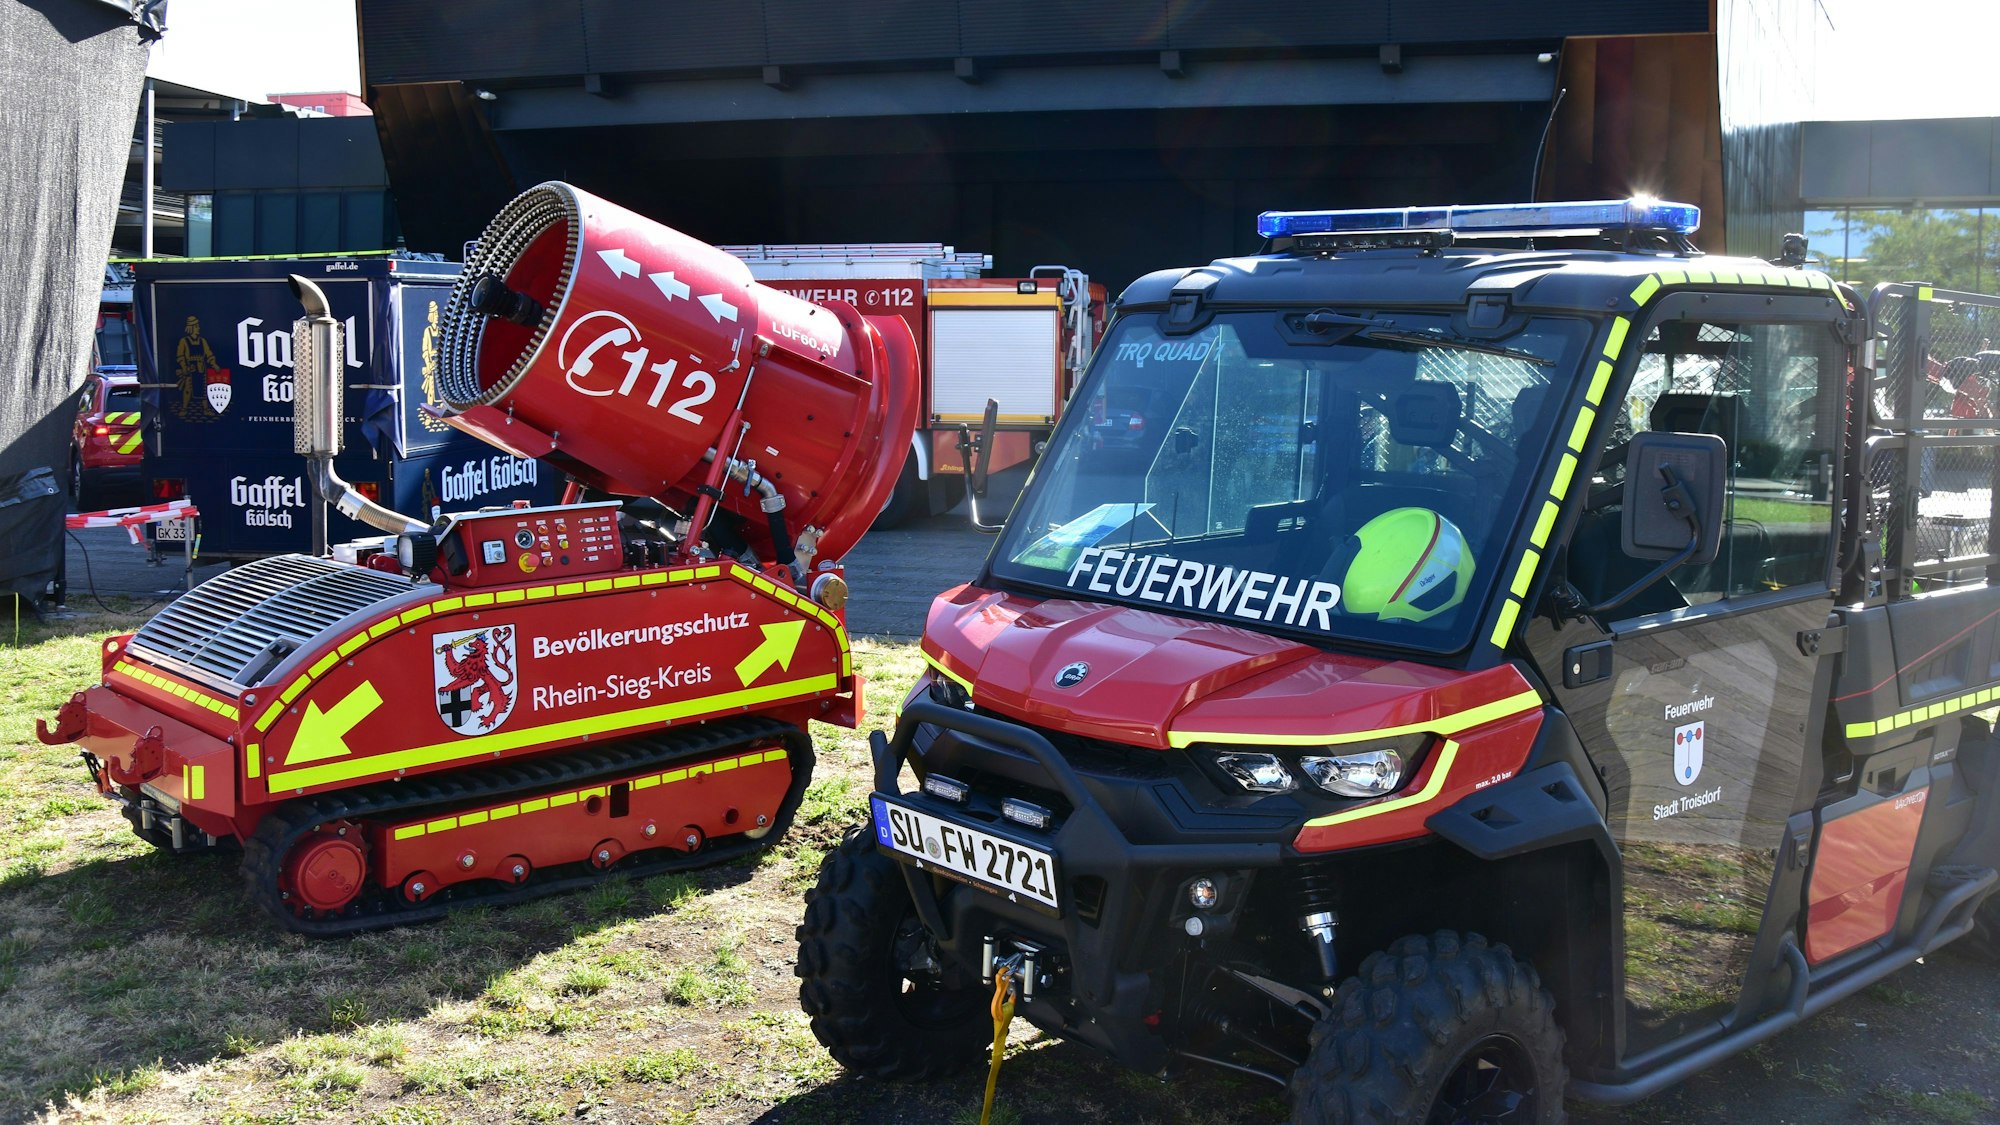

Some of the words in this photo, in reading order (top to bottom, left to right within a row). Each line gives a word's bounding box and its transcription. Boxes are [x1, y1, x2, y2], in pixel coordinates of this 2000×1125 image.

[326, 262, 358, 272] gaffel.de
[882, 288, 914, 306] 112
[237, 315, 364, 368] Gal
[772, 321, 840, 358] LUF60.AT
[1154, 343, 1209, 361] QUAD
[618, 347, 716, 425] 112
[231, 475, 306, 509] Gaffel
[442, 458, 489, 502] Gaffel
[158, 528, 171, 539] GK
[1067, 547, 1341, 631] FEUERWEHR
[532, 611, 749, 659] Bevölkerungsschutz
[532, 662, 712, 711] Rhein-Sieg-Kreis
[1664, 695, 1715, 721] Feuerwehr
[1475, 779, 1491, 790] max.
[1491, 774, 1501, 784] 2,0
[1501, 771, 1512, 780] bar
[1653, 803, 1679, 821] Stadt
[1680, 786, 1722, 812] Troisdorf
[880, 826, 888, 838] D
[890, 809, 925, 855] SU
[940, 825, 977, 873] FW
[982, 839, 1054, 901] 2721
